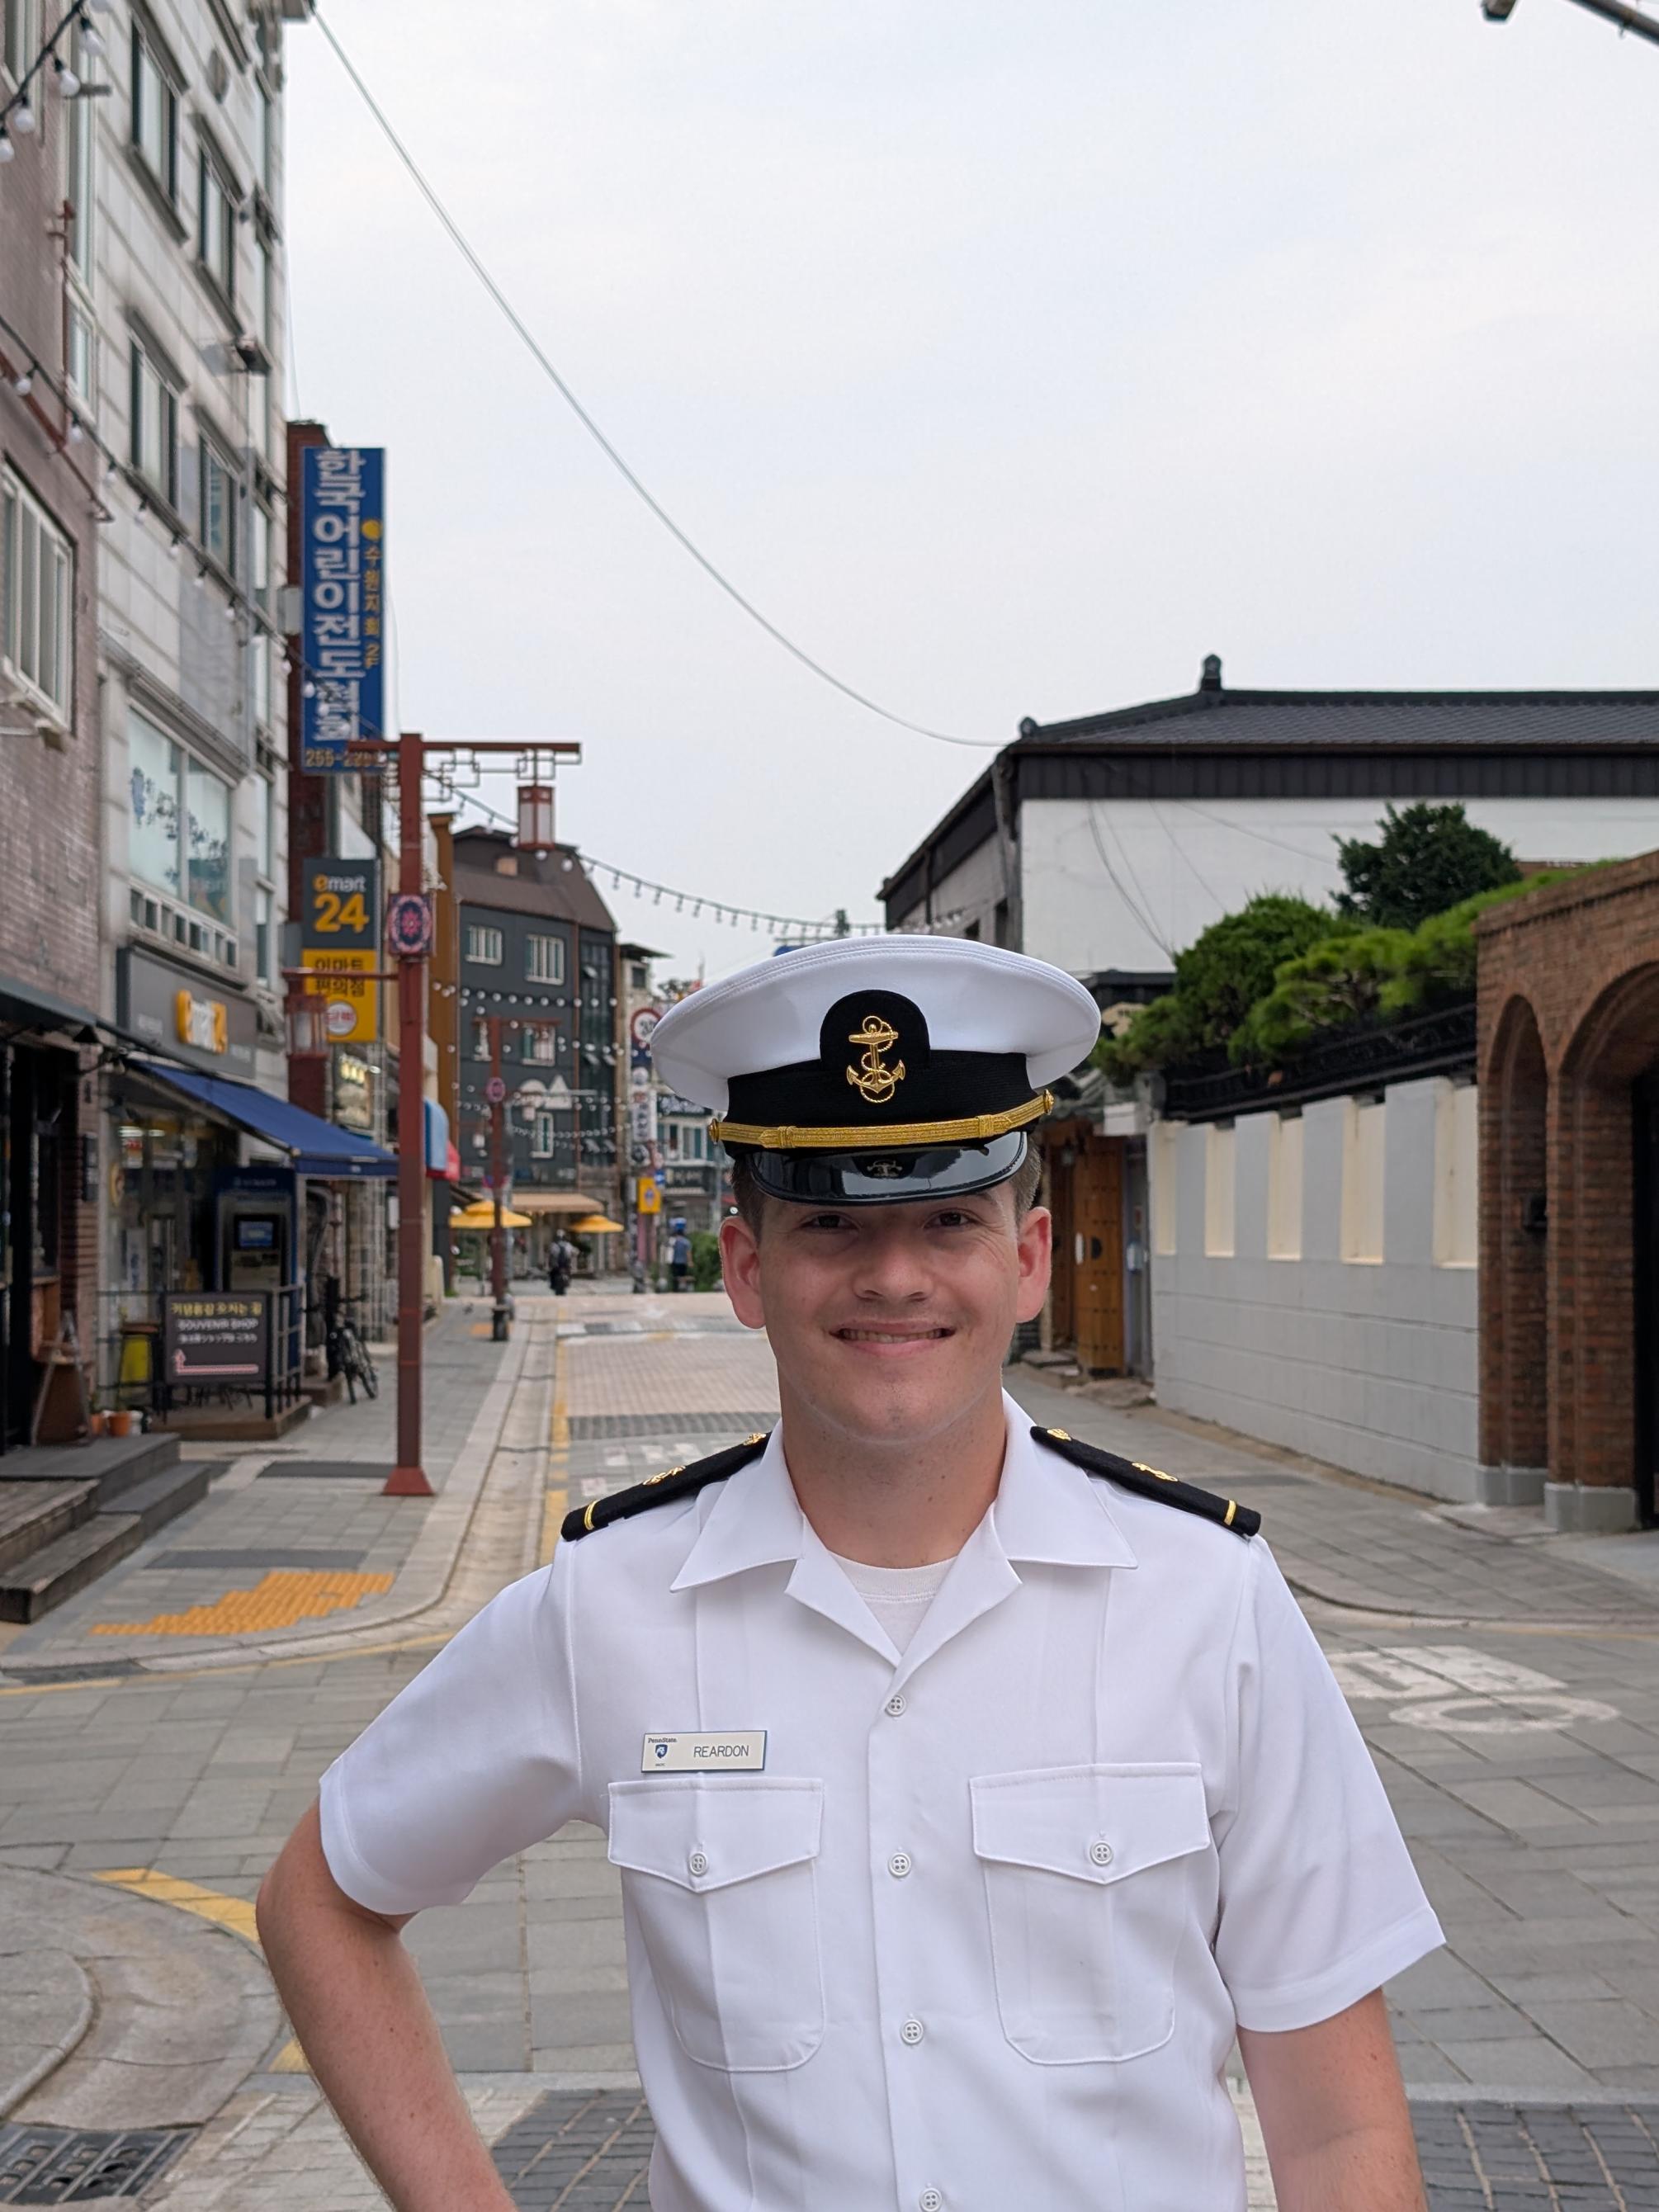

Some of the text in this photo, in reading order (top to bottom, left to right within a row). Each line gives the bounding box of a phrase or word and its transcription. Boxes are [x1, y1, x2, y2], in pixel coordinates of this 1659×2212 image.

[313, 874, 366, 892] emart
[314, 892, 370, 933] 24
[314, 957, 364, 971] 이마트
[693, 1745, 749, 1757] REARDON
